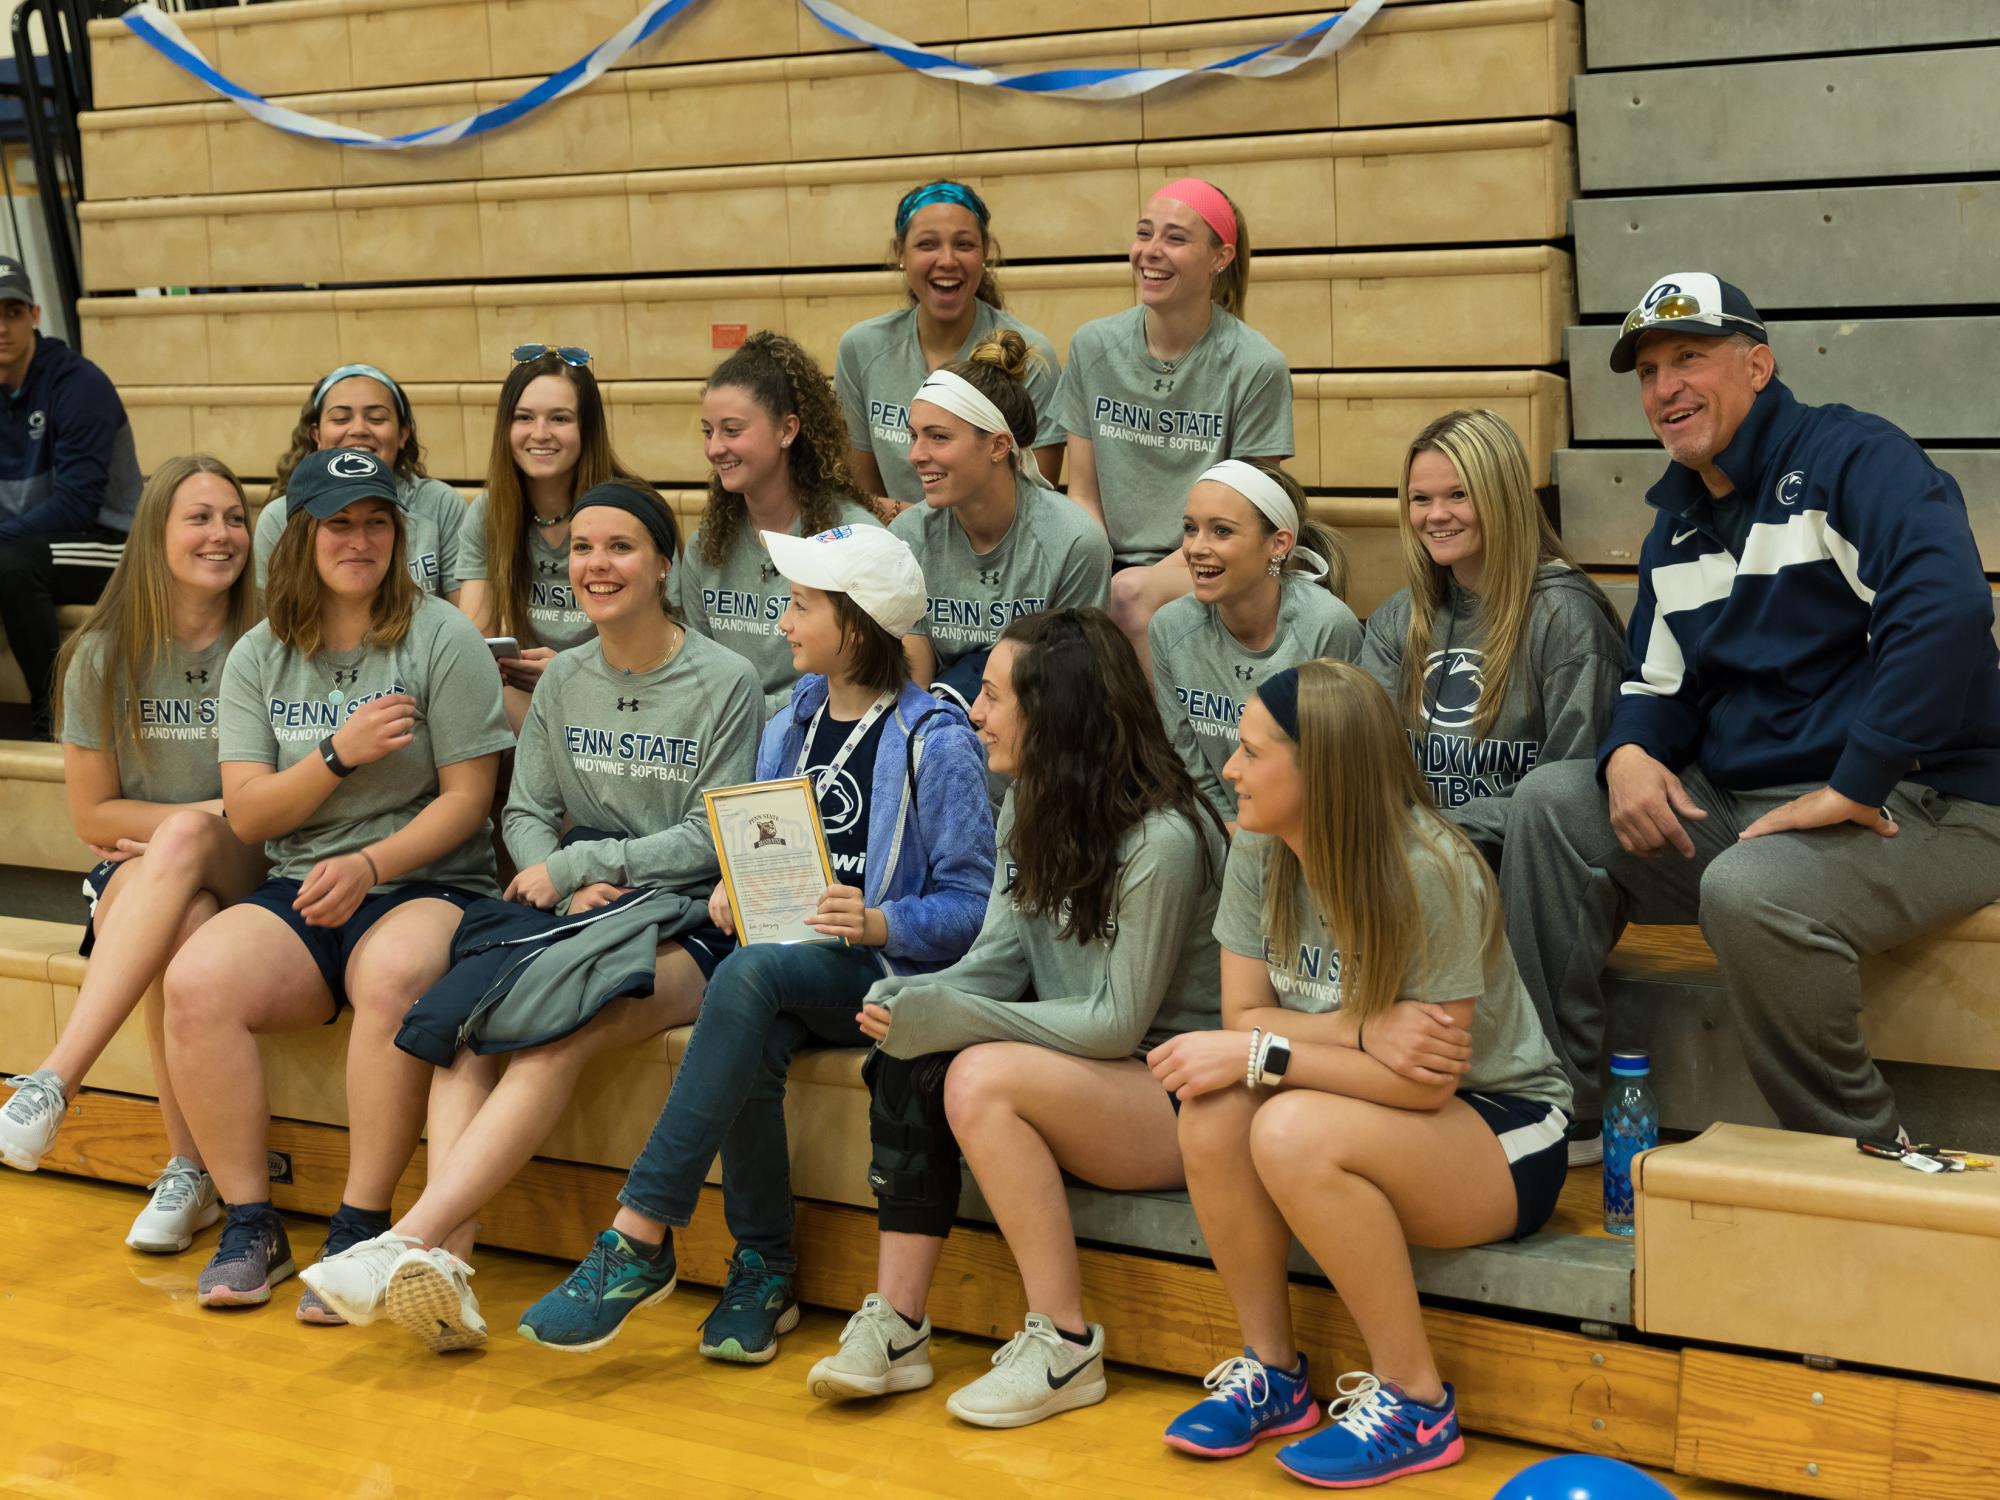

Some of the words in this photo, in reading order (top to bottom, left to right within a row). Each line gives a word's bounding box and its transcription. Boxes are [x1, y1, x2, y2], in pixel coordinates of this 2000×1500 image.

[870, 399, 911, 430] PEN
[1094, 396, 1152, 432] PENN
[1158, 409, 1224, 439] STATE
[873, 426, 911, 444] BRANDY
[1099, 424, 1165, 448] BRANDYWINE
[702, 588, 760, 619] PENN
[709, 617, 770, 636] BRANDYWINE
[931, 626, 997, 643] RANDYWINE
[125, 698, 192, 725] ENN
[269, 698, 340, 728] PENN
[139, 727, 207, 740] RANDYWINE
[274, 727, 335, 742] BRANDYW
[618, 732, 700, 769] STATE
[573, 757, 625, 776] ANDYWINE
[630, 764, 690, 783] SOFTBALL
